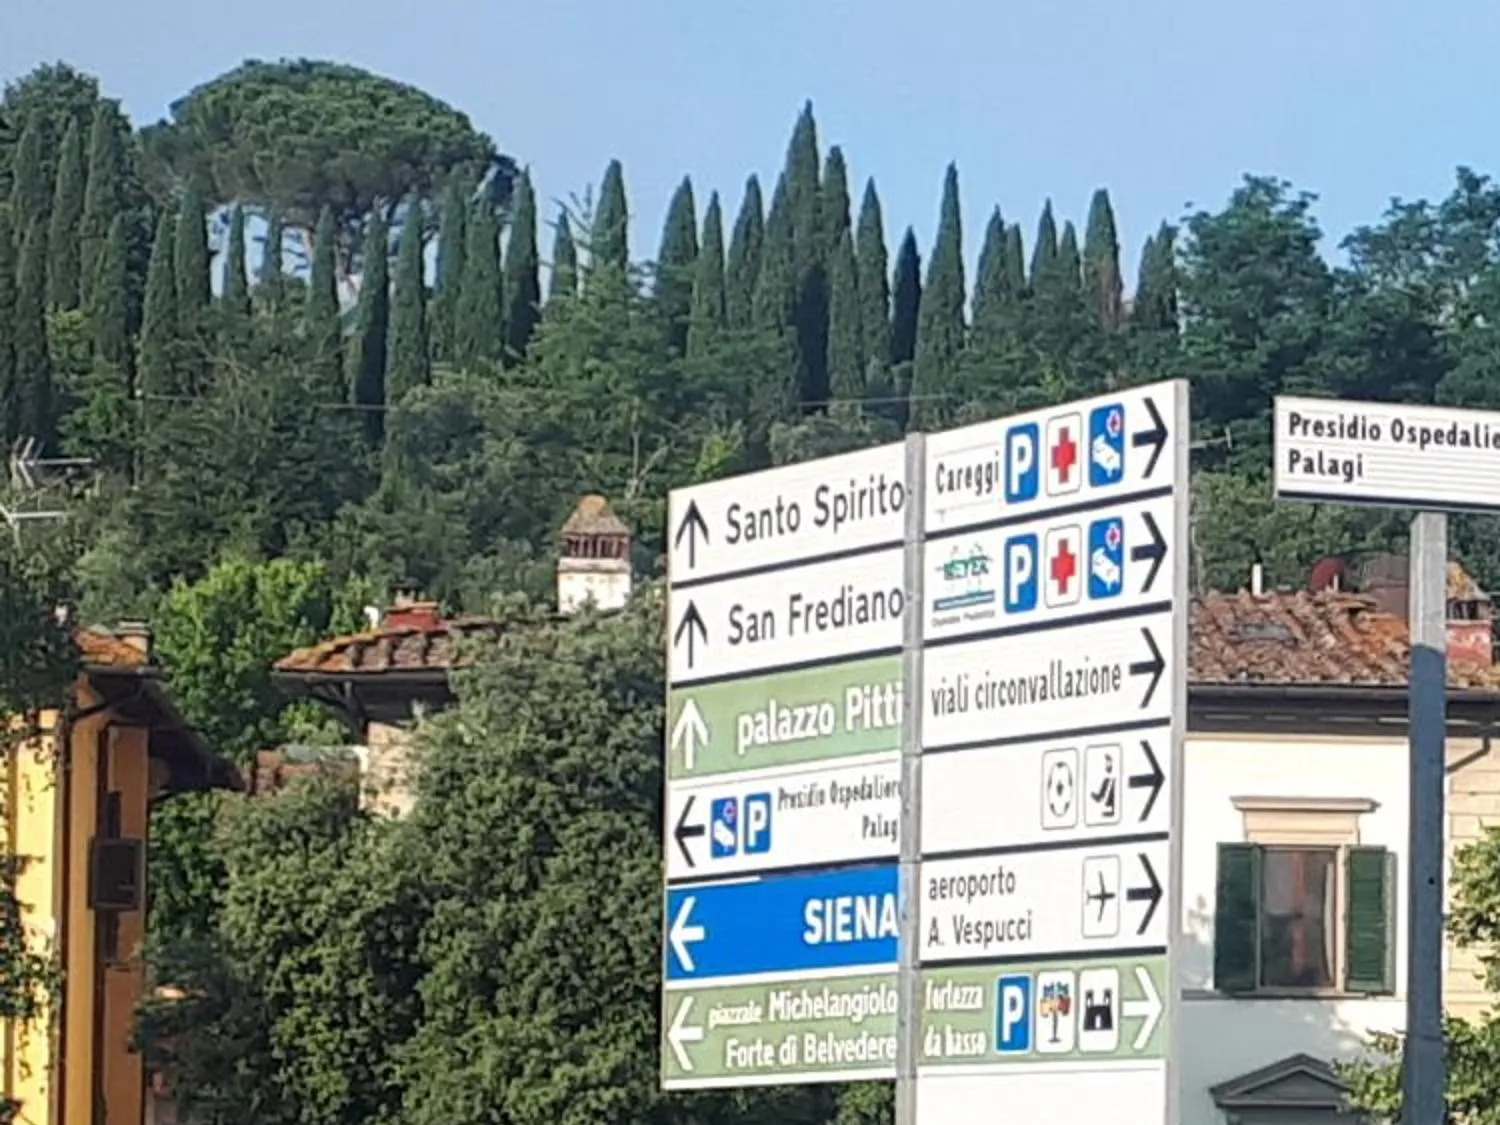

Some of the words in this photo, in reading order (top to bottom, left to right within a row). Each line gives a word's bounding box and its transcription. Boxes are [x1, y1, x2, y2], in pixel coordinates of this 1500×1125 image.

[1289, 413, 1381, 441] Presidio
[936, 450, 998, 496] Careggi
[1288, 450, 1364, 482] Palagi
[726, 497, 800, 544] Santo
[813, 475, 904, 529] Spirito
[727, 598, 775, 646] San
[788, 584, 903, 632] Frediano
[931, 675, 969, 716] viali
[975, 656, 1121, 710] circonvallazione
[738, 698, 836, 755] palazzo
[845, 681, 903, 731] Pitti
[777, 782, 826, 811] Presidio
[862, 814, 898, 843] Palag
[929, 866, 1016, 908] aeroporto
[803, 894, 899, 944] SIENA
[928, 914, 943, 946] A.
[953, 910, 1032, 950] Vespucci
[708, 1000, 762, 1029] piazzale
[768, 983, 898, 1023] Michelangiolo
[925, 979, 983, 1011] fortezza
[725, 1038, 774, 1068] Forte
[779, 1034, 798, 1065] di
[804, 1030, 897, 1063] Belvedere
[924, 1025, 942, 1057] da
[945, 1022, 987, 1056] basso
